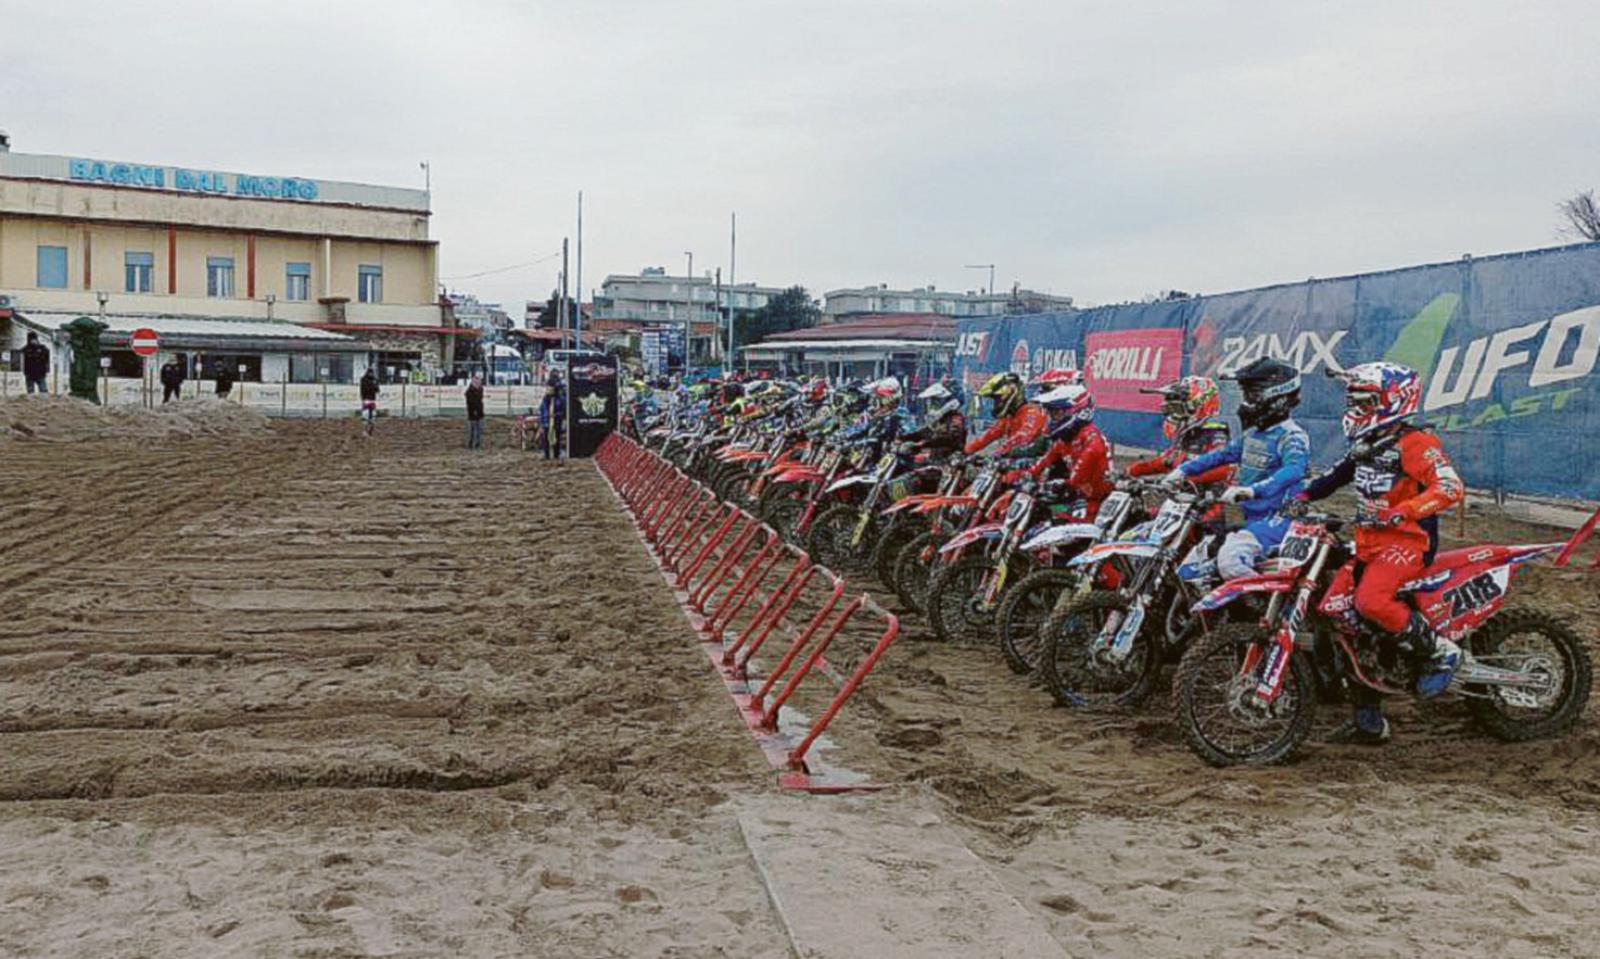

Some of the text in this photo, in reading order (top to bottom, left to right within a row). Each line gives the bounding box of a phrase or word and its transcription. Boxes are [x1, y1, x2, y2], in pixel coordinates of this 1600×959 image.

[69, 158, 318, 200] BAGNI DAL MORO
[1092, 347, 1164, 381] BORILLI
[1217, 330, 1349, 375] 24MX
[1424, 304, 1600, 412] UFO
[1442, 571, 1503, 619] 208
